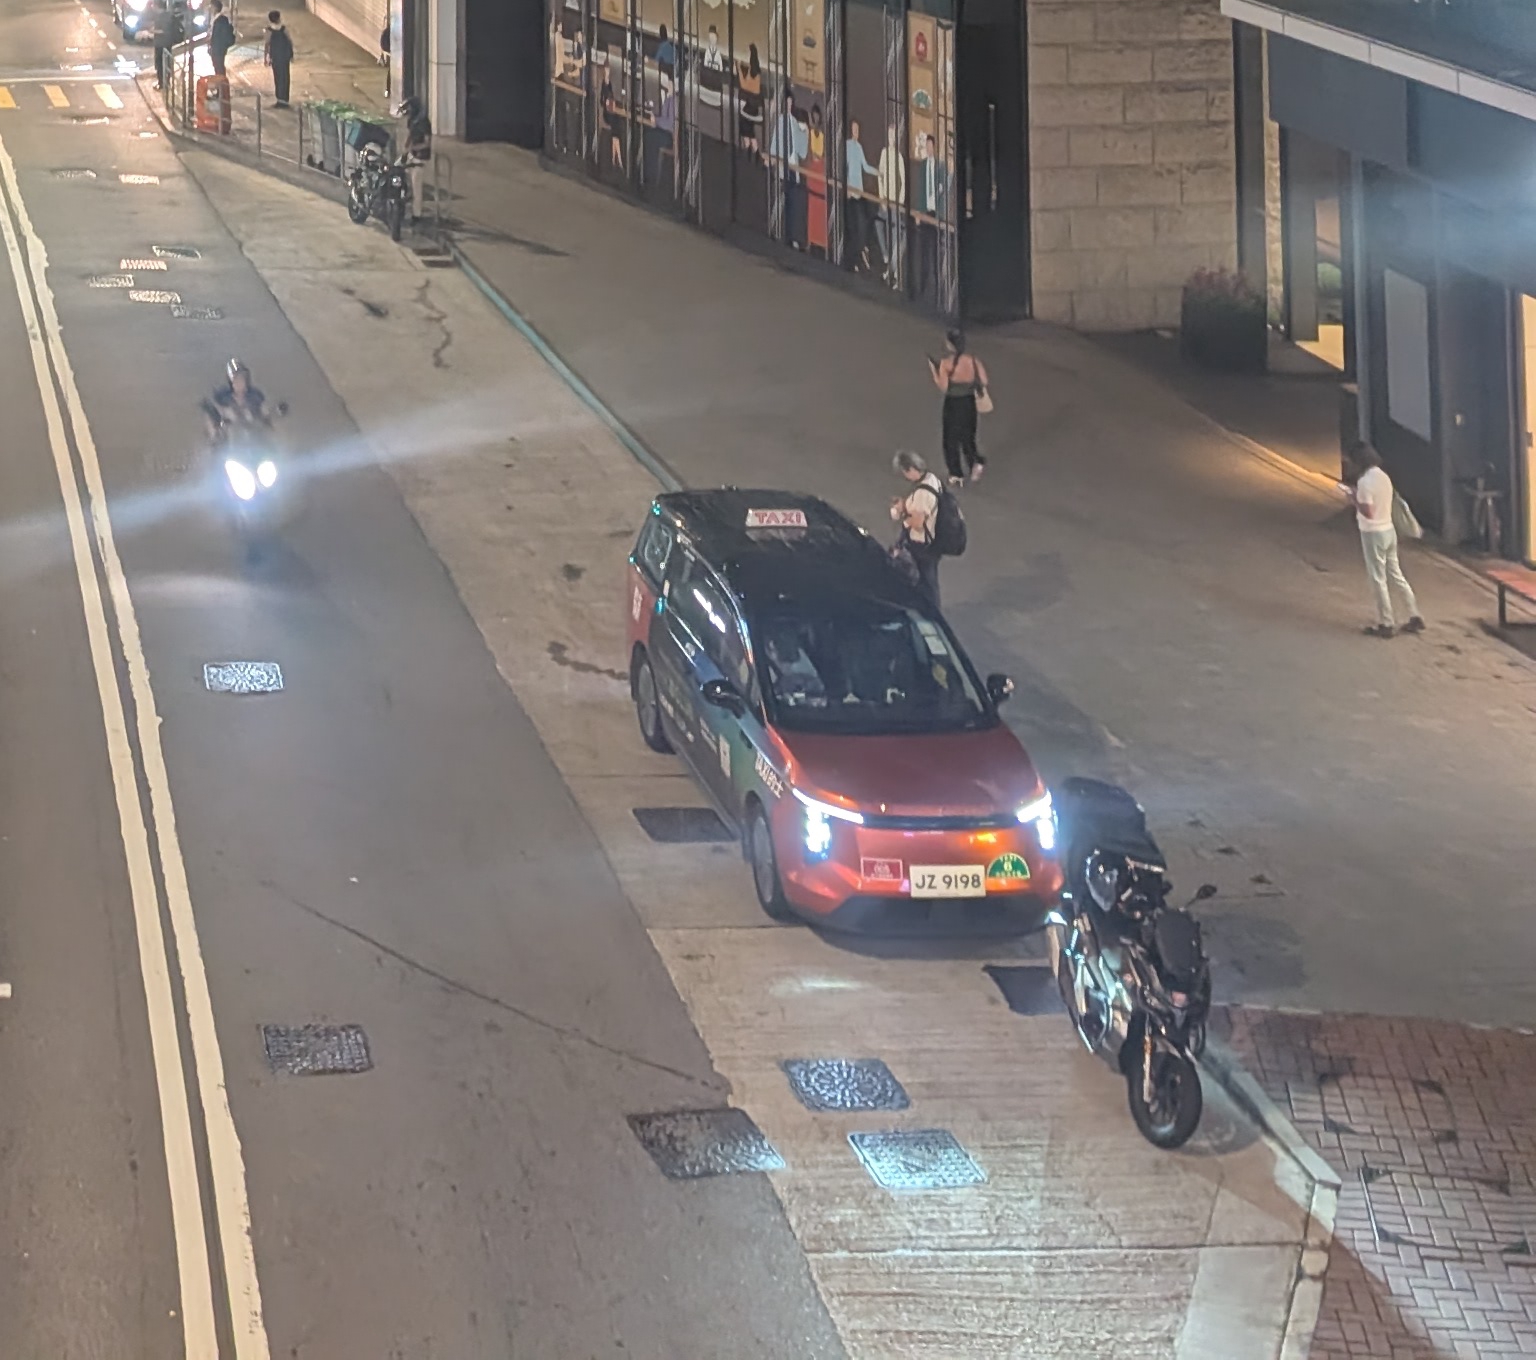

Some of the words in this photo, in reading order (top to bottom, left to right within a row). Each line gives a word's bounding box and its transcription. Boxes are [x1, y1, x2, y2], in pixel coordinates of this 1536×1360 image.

[755, 511, 802, 524] TAXI
[915, 874, 937, 890] JZ
[942, 873, 982, 889] 9198
